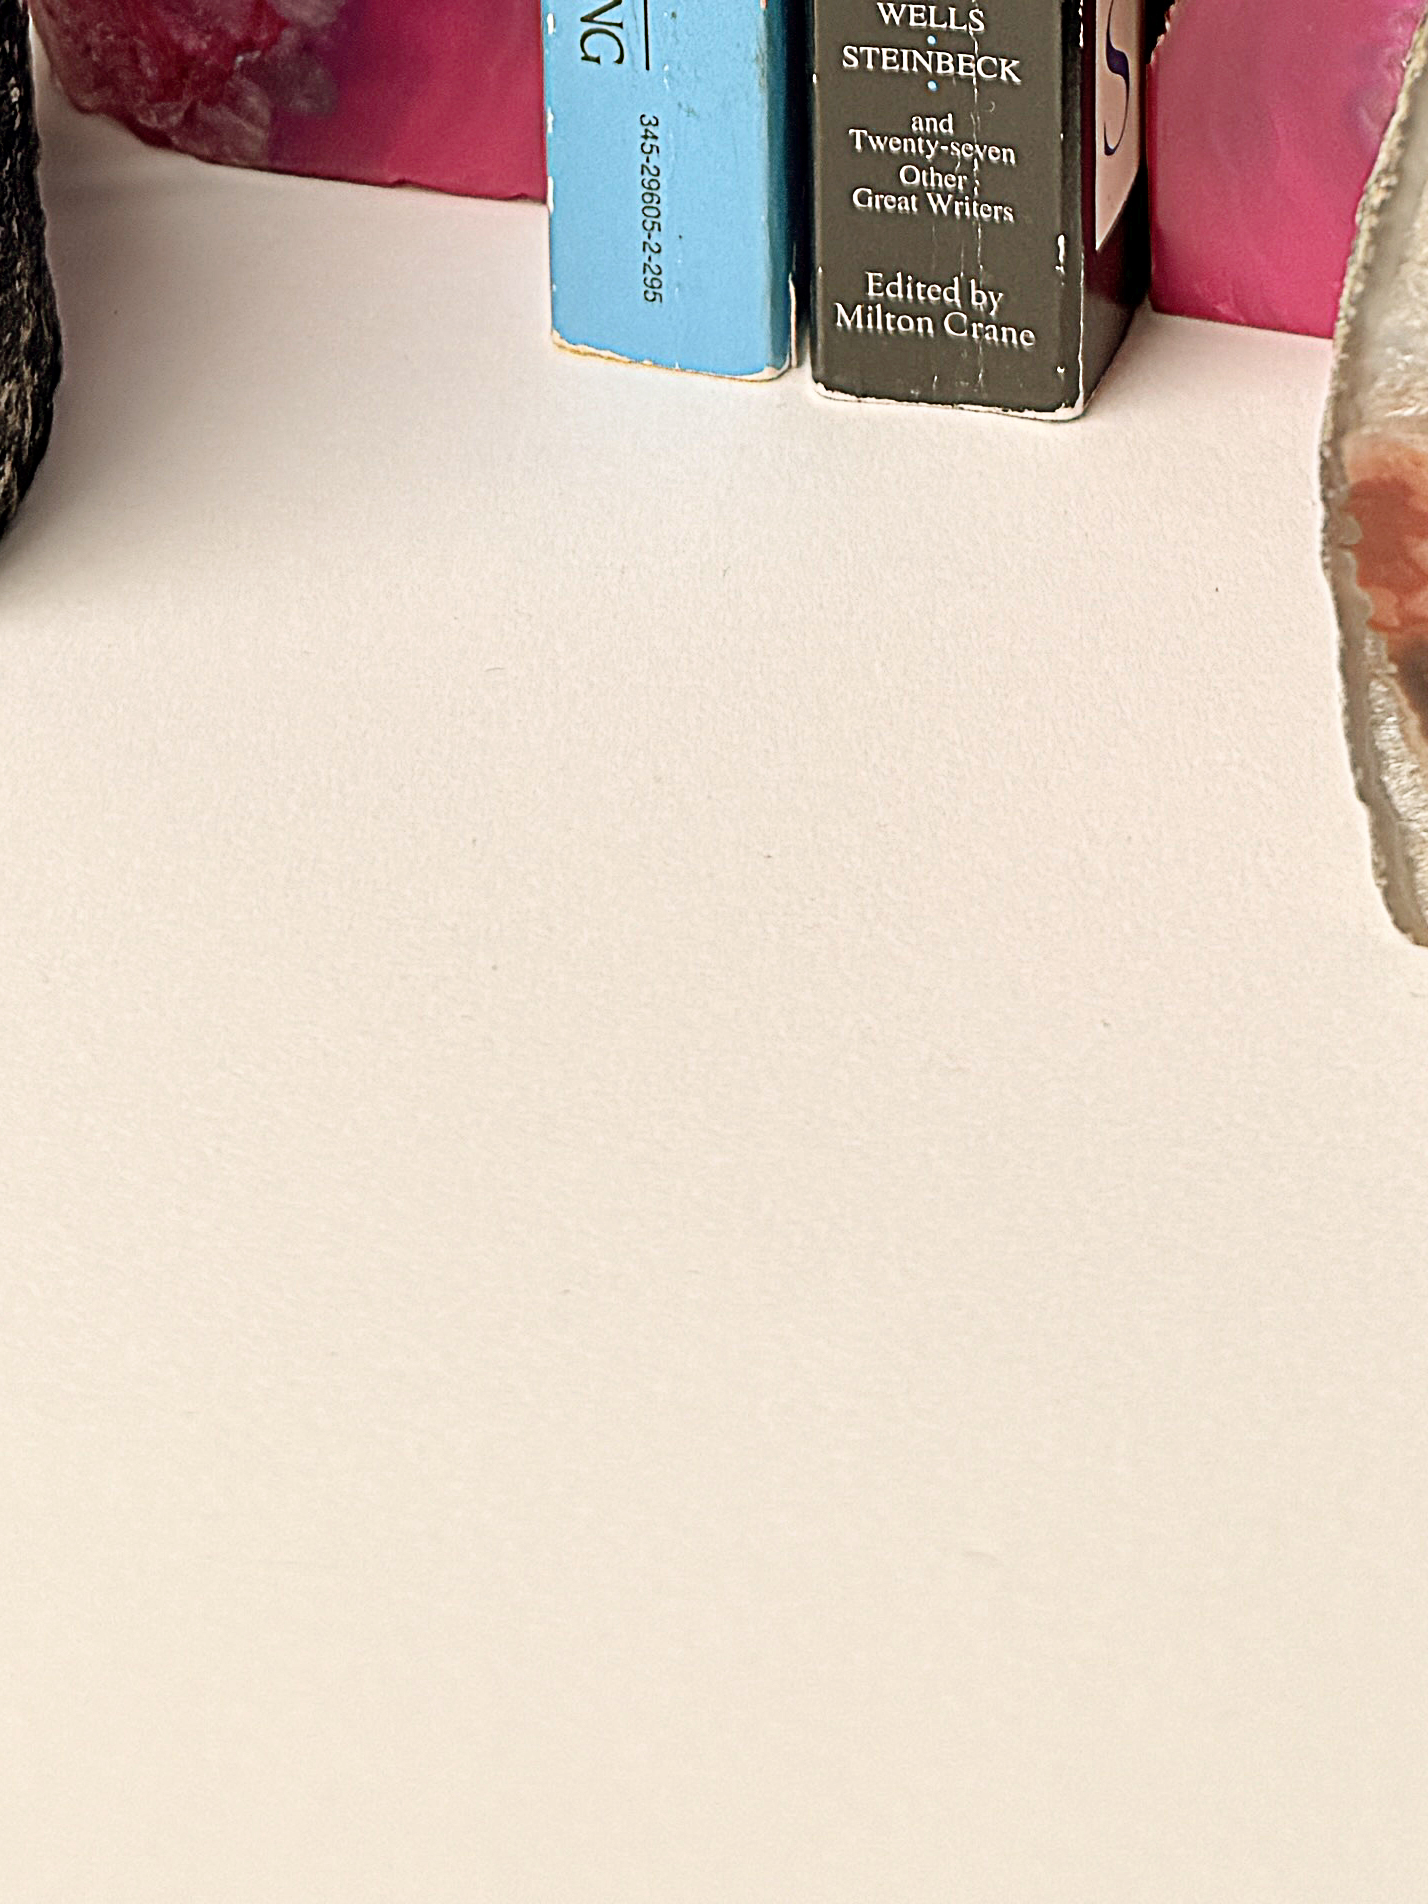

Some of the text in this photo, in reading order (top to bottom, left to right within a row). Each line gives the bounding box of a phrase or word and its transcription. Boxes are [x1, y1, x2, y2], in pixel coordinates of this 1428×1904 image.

[876, 2, 986, 33] WELLS
[842, 45, 1022, 84] STEINBECK
[910, 112, 954, 135] and
[848, 128, 1016, 166] Twenty-seven
[899, 164, 968, 191] Other
[639, 113, 664, 305] 345-29605-2-295
[852, 187, 1014, 223] Great Writers
[864, 271, 1004, 316] Edited by
[834, 303, 1037, 349] Milton Crane
